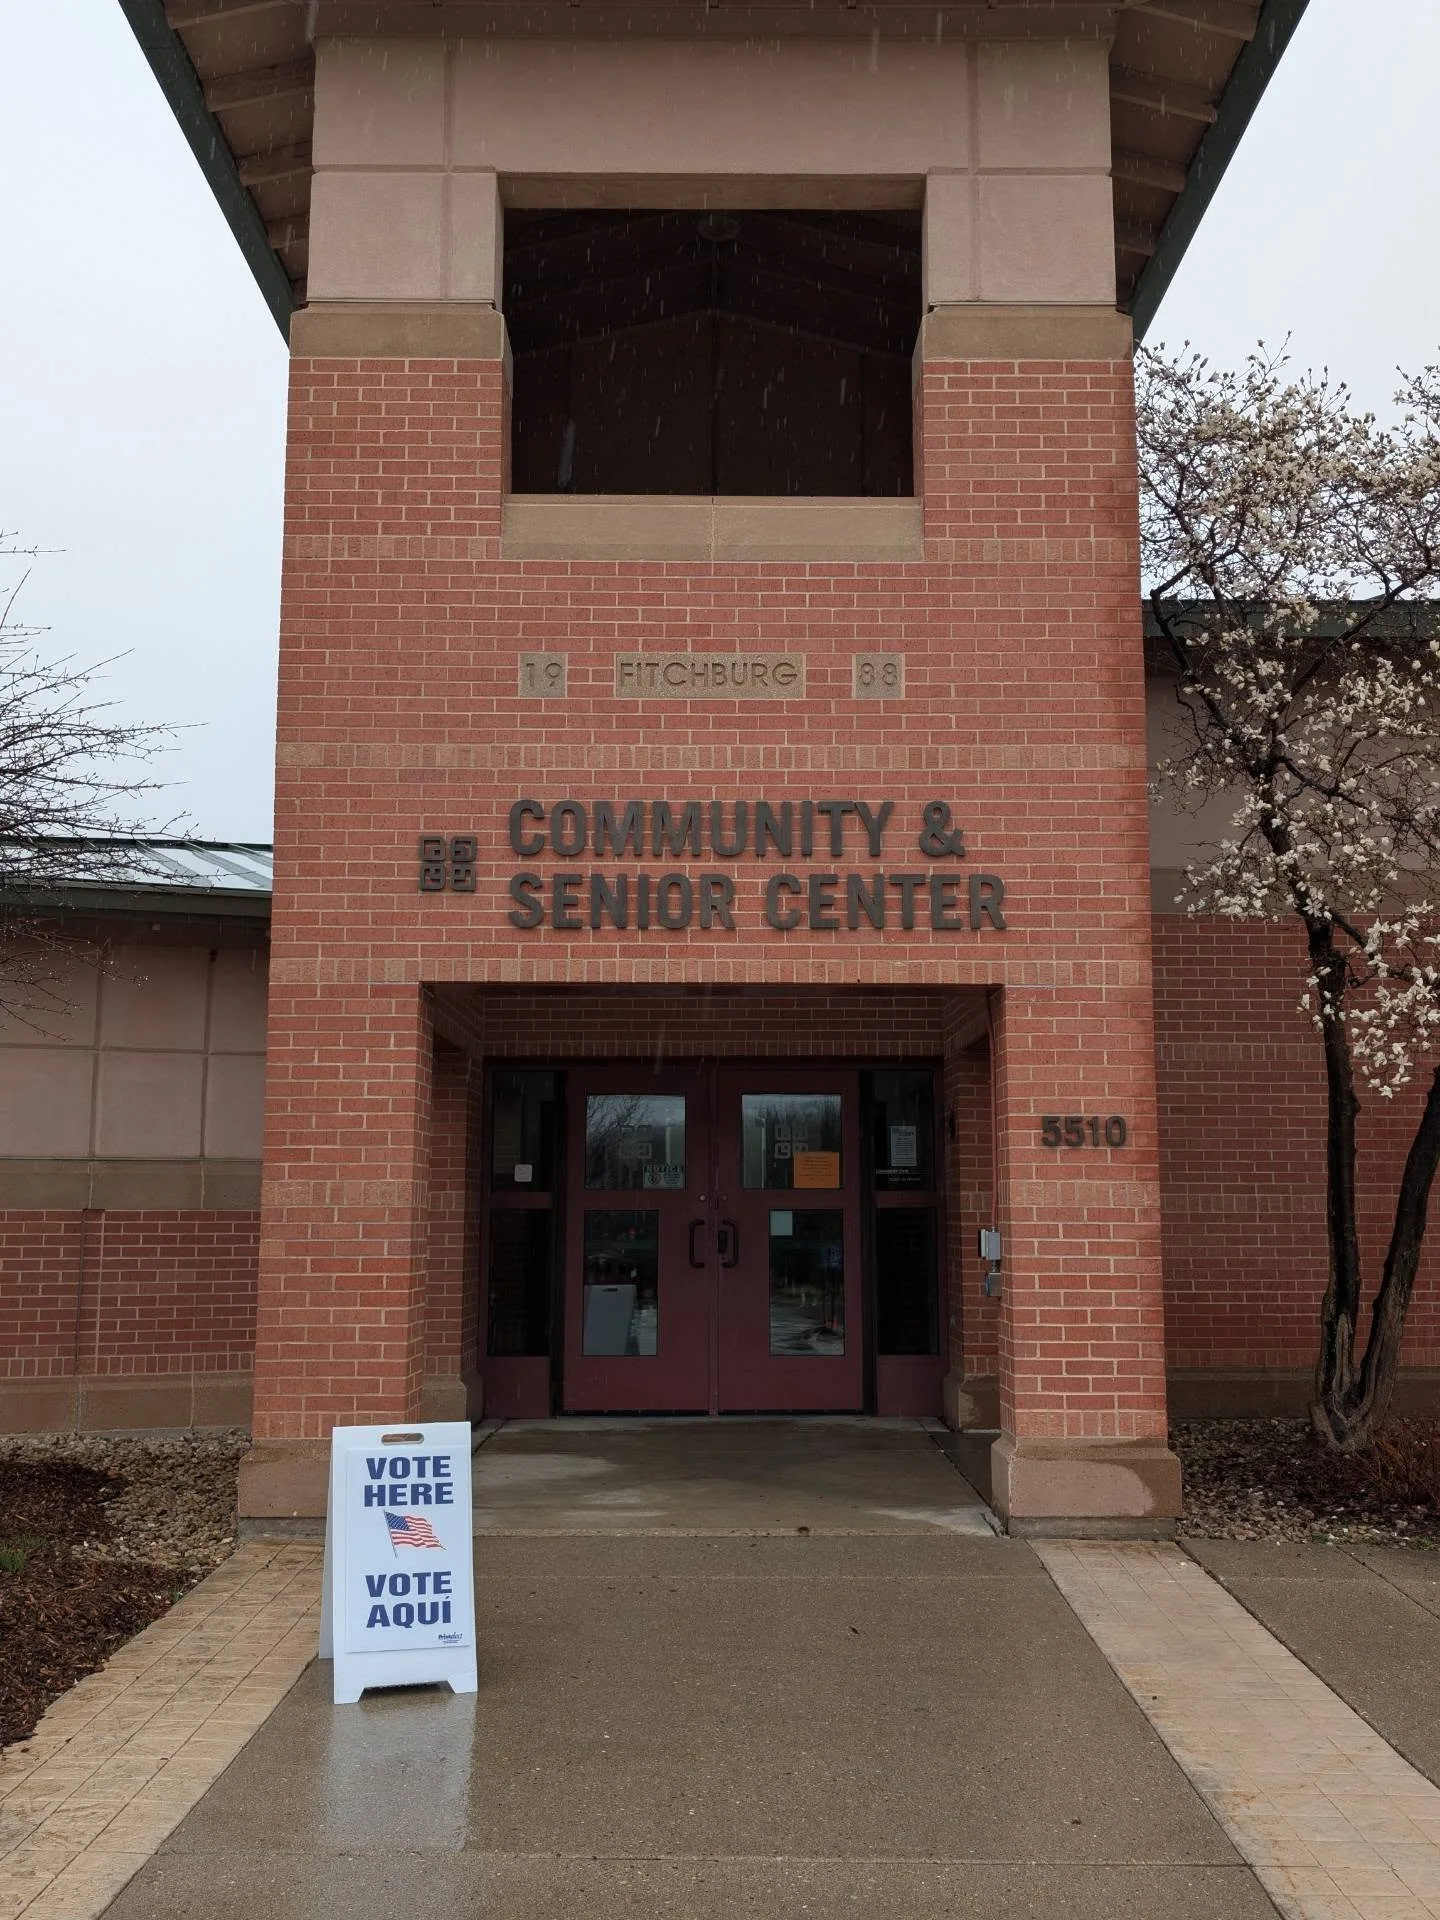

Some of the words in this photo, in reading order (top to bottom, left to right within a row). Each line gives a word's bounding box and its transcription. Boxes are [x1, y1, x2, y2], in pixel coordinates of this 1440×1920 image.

[525, 661, 561, 690] 19
[619, 661, 798, 687] FITCHBURG
[858, 661, 899, 686] 88
[509, 800, 893, 857] COMMUNITY
[919, 801, 965, 856] &
[508, 873, 735, 928] SENIOR
[766, 873, 1006, 930] CENTER
[1042, 1116, 1126, 1147] 5510
[366, 1456, 451, 1480] VOTE
[364, 1482, 453, 1507] HERE
[365, 1571, 452, 1597] VOTE
[366, 1596, 451, 1628] AQUÍ
